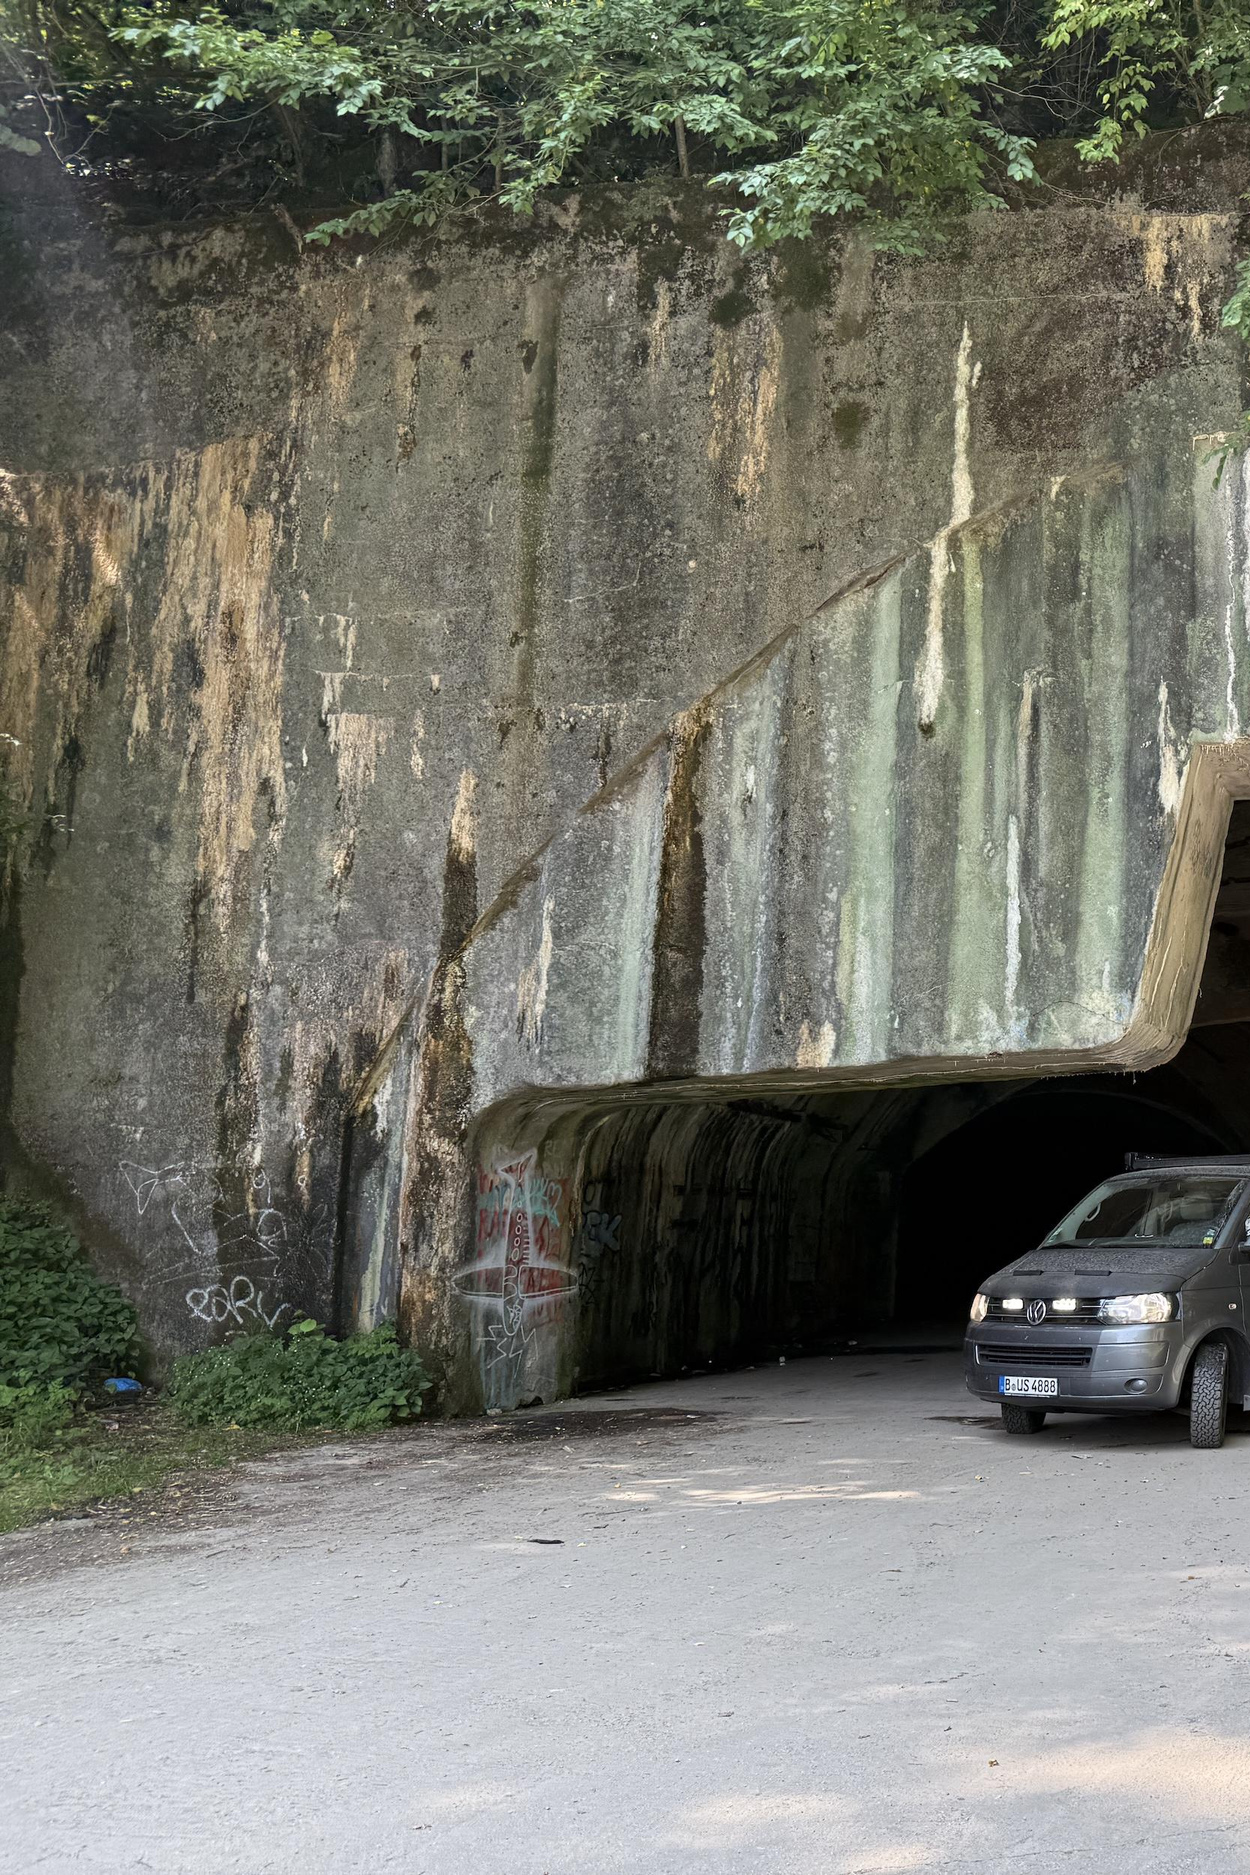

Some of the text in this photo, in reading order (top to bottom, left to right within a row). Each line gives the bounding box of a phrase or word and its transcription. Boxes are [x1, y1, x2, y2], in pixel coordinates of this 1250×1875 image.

[1005, 1378, 1056, 1393] B US 4888
